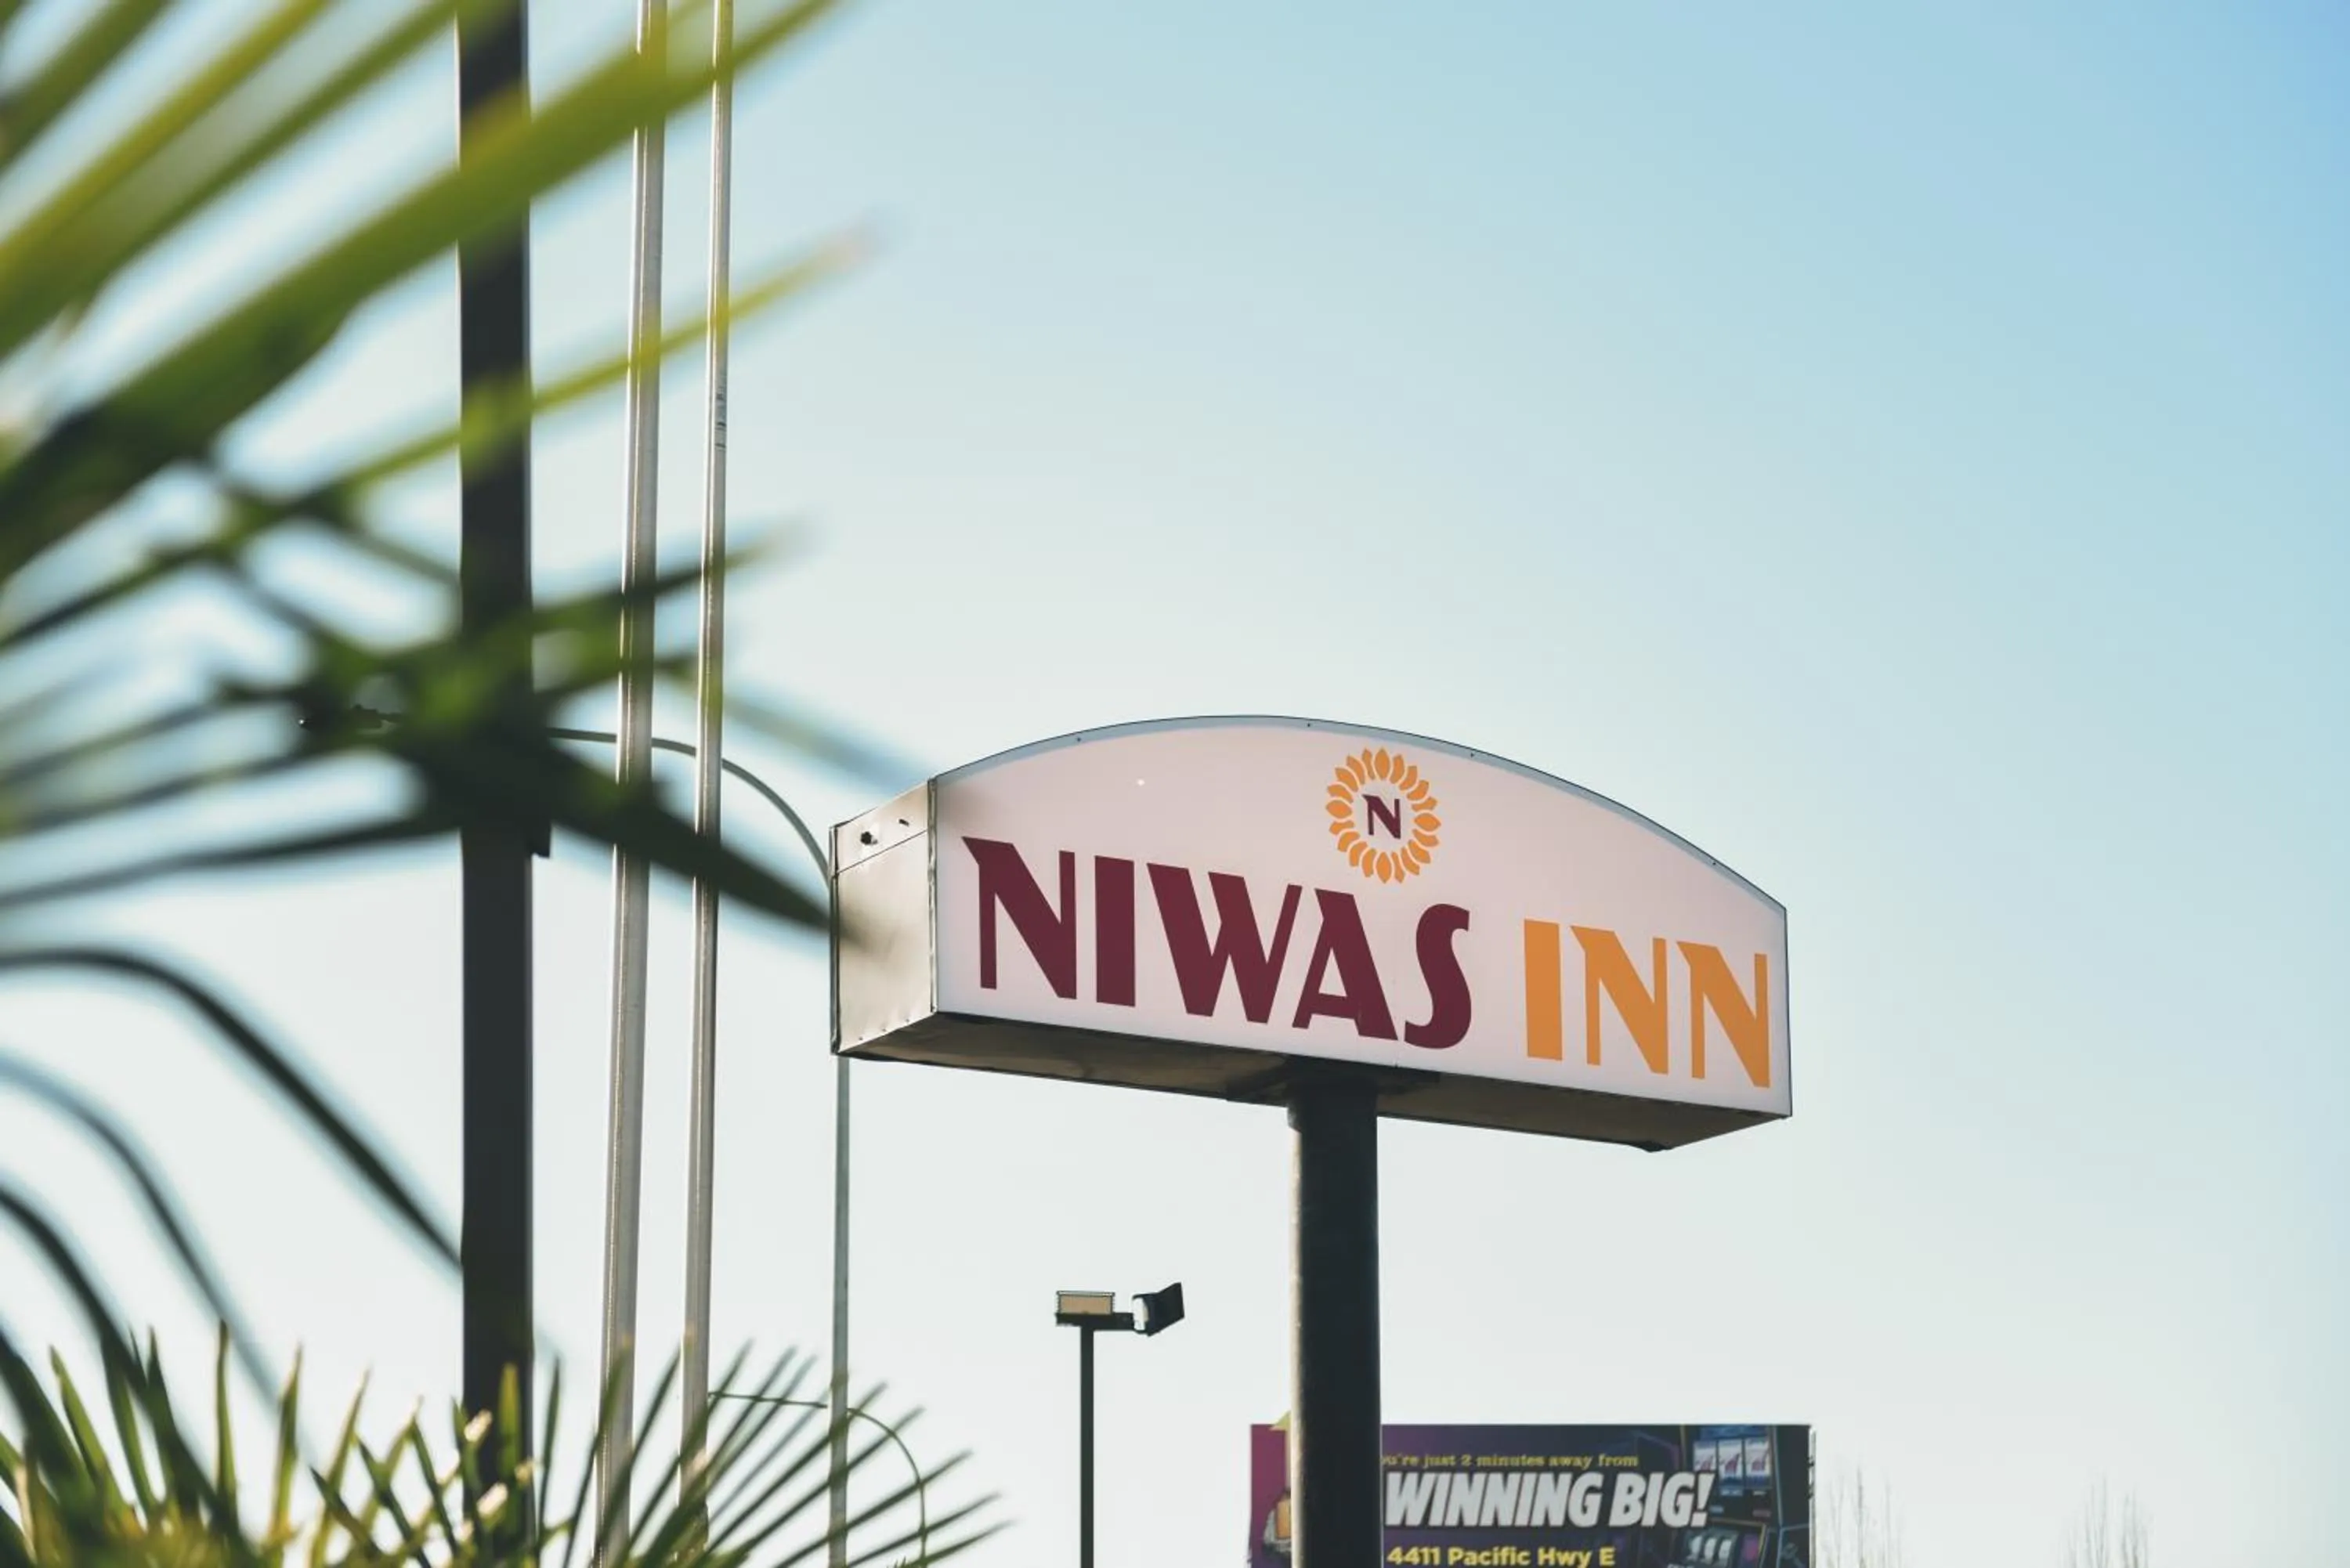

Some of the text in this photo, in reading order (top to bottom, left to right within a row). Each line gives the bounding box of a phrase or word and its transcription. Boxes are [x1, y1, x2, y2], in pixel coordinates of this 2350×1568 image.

[1362, 793, 1401, 839] N
[961, 836, 1770, 1088] NIWAS INN
[1423, 1454, 1456, 1469] just
[1461, 1454, 1472, 1466] 2
[1477, 1454, 1545, 1466] minutes
[1549, 1456, 1593, 1470] away
[1598, 1454, 1638, 1466] from
[1385, 1472, 1716, 1527] WINNING BIG!
[1387, 1546, 1615, 1568] 4411 Pacific Hwy E
